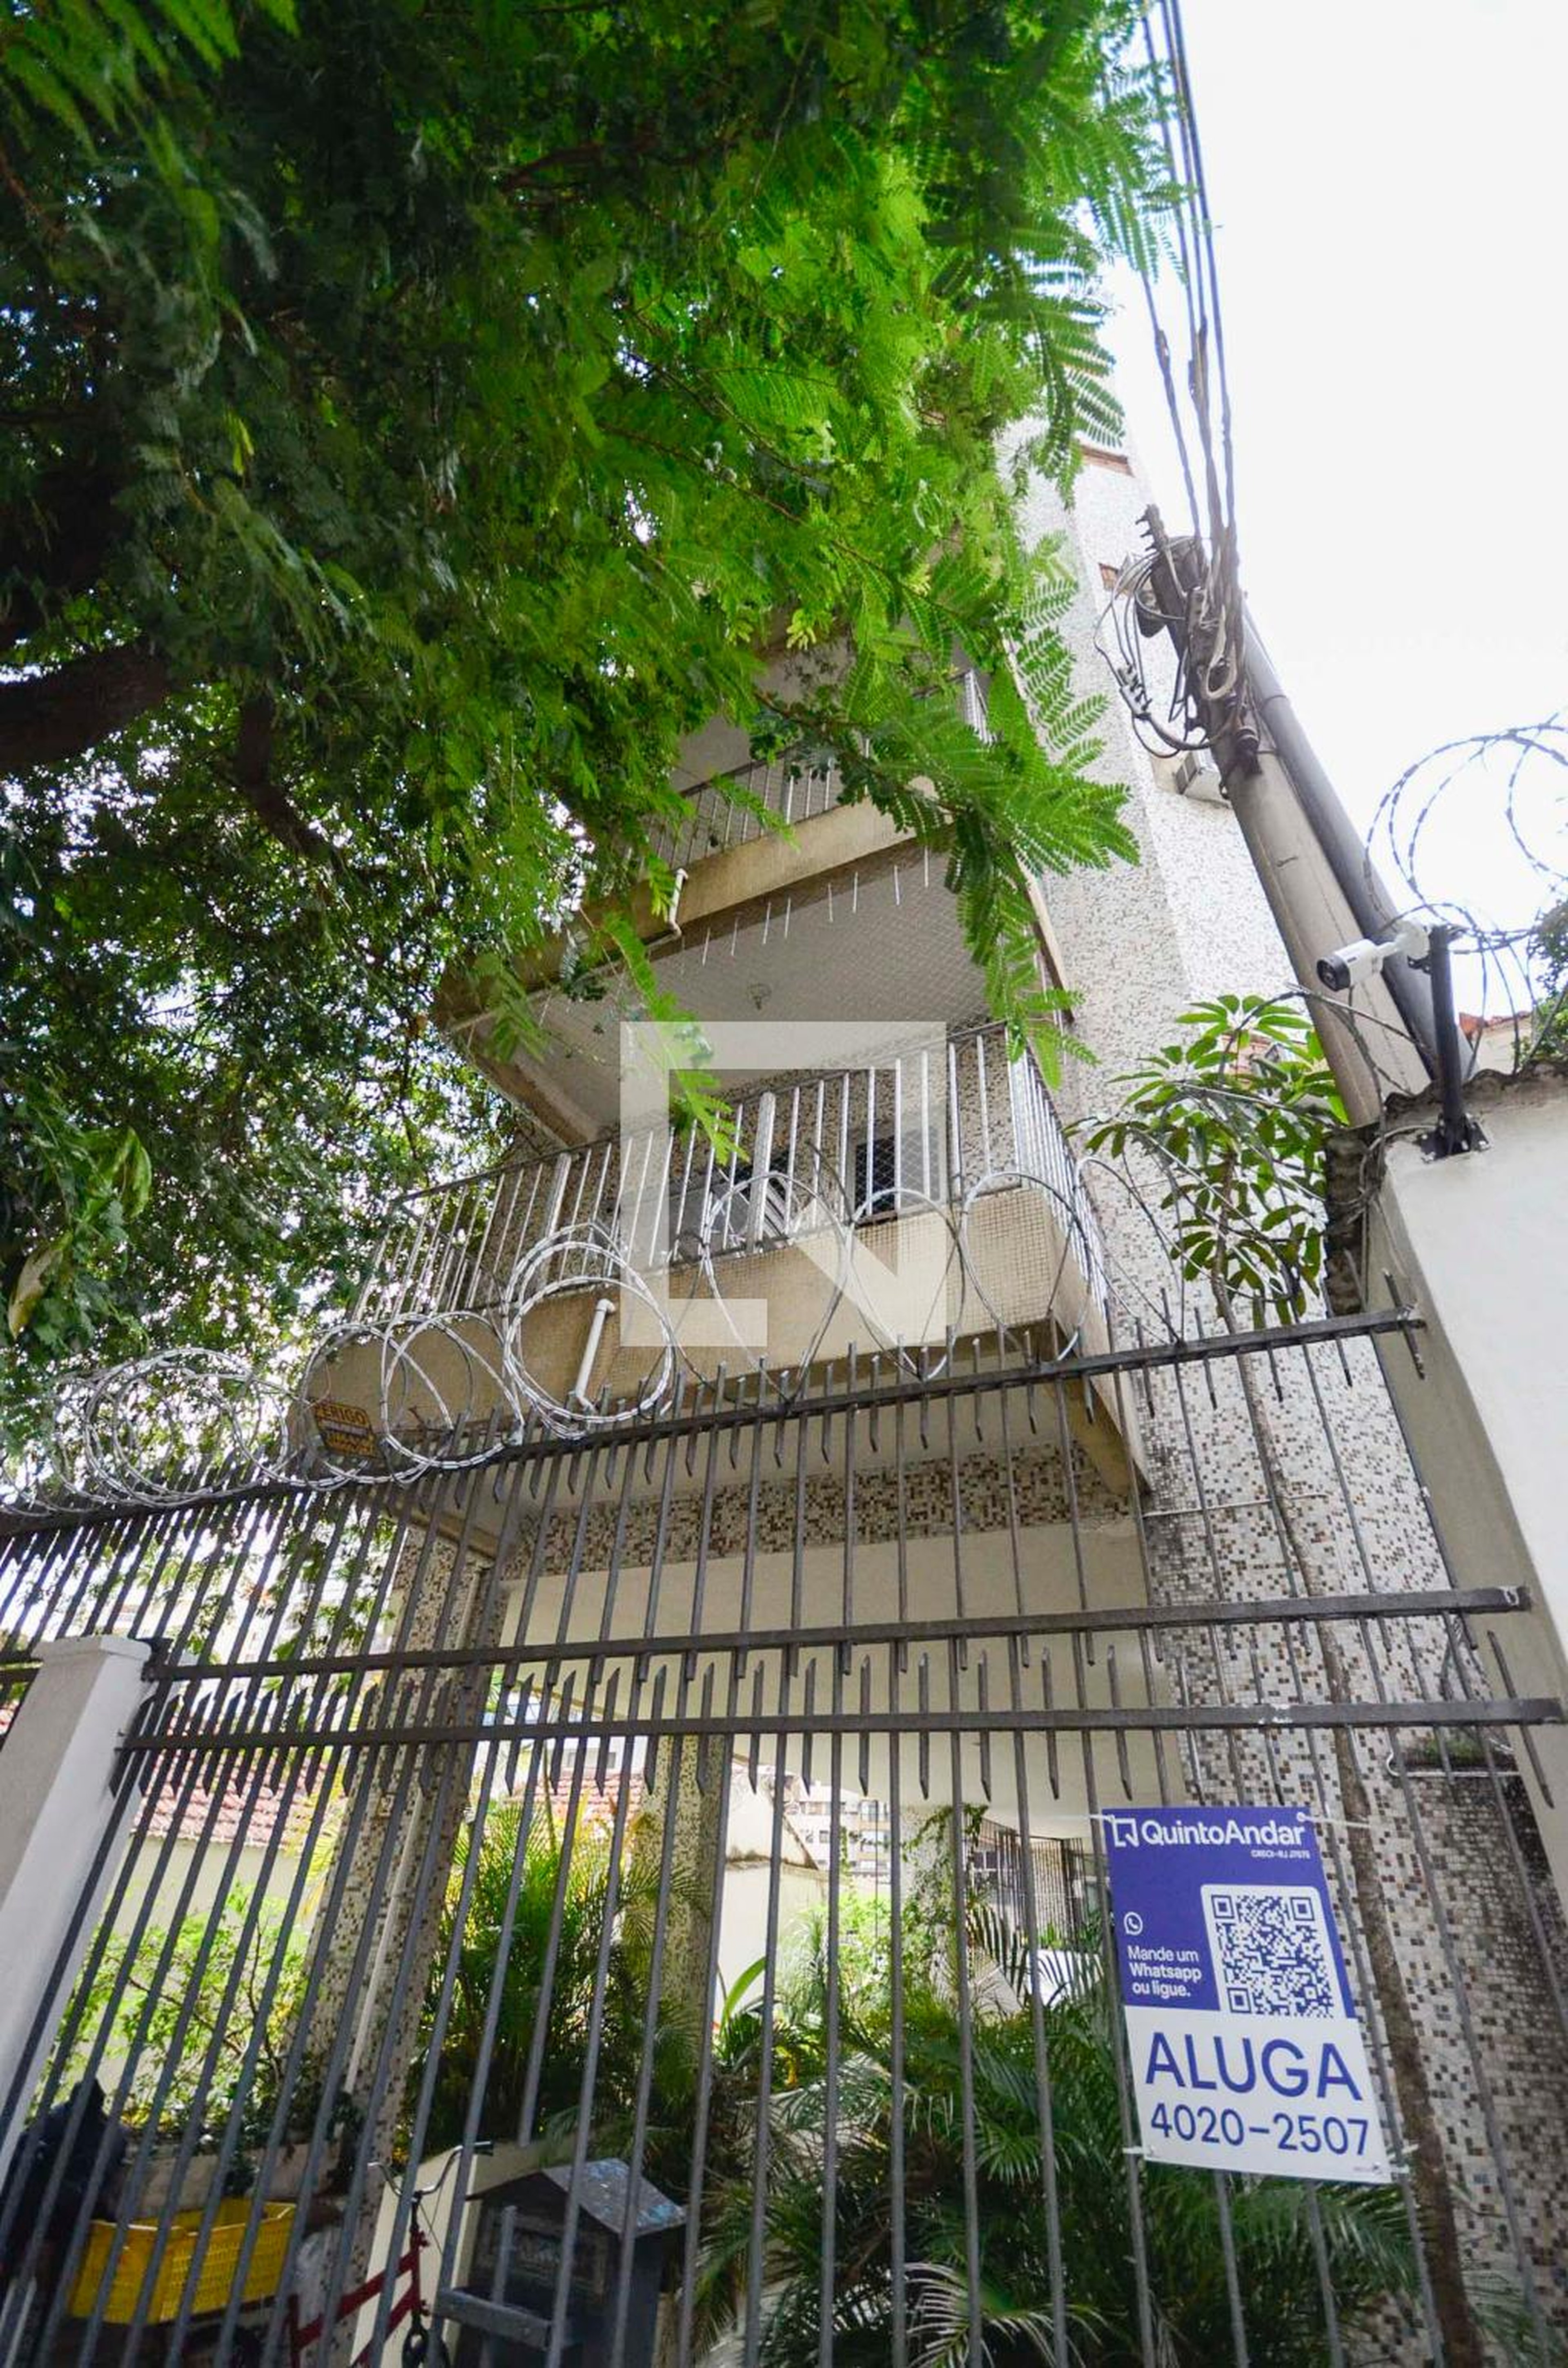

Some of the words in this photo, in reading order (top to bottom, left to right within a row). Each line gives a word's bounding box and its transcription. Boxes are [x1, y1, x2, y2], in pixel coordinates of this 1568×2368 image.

[1141, 1820, 1305, 1846] QuintoAndar
[1127, 1945, 1174, 1961] Mande
[1176, 1951, 1199, 1962] um
[1129, 1962, 1202, 1983] Whatsapp
[1132, 1982, 1150, 1994] ou
[1151, 1980, 1191, 1999] ligue.
[1146, 2032, 1363, 2101] ALUGA
[1151, 2103, 1368, 2155] 4020-2507
